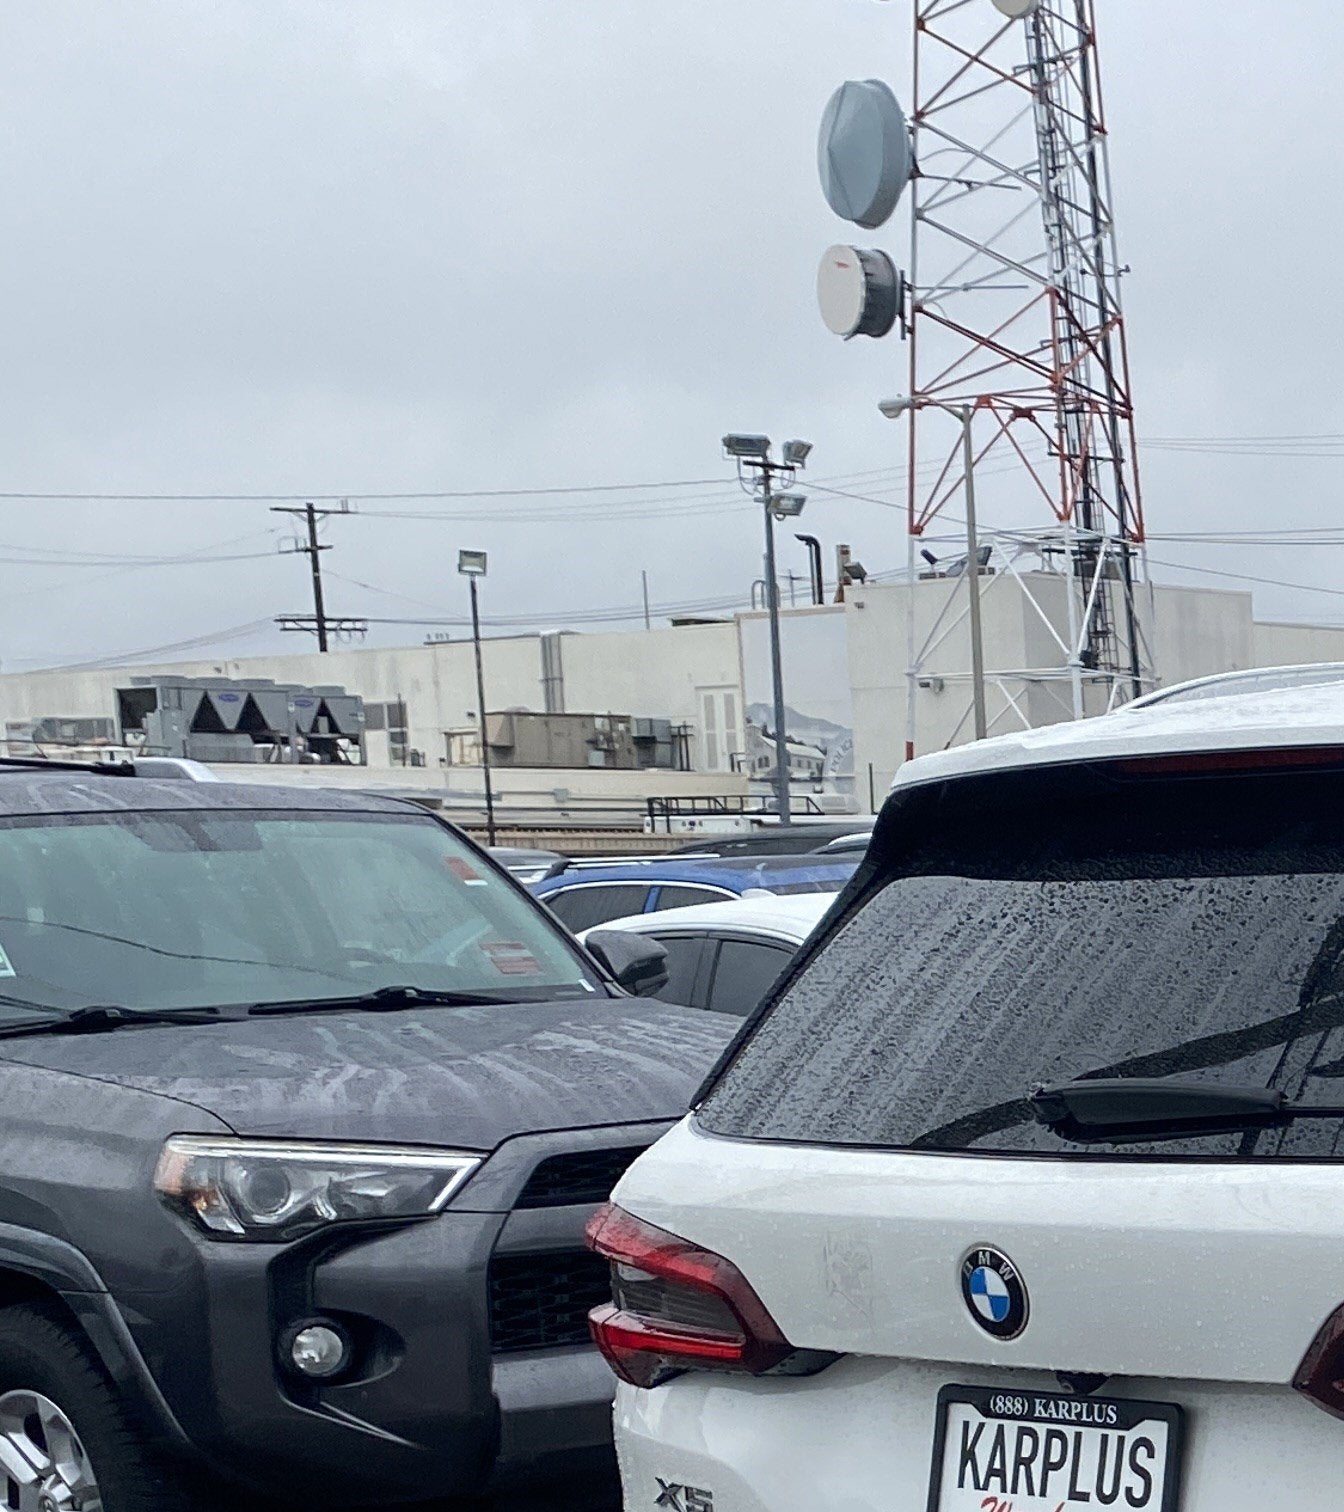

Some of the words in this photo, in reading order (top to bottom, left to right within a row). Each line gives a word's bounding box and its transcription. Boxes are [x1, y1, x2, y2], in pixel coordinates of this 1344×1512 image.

[963, 1251, 1015, 1281] BMW
[990, 1394, 1029, 1417] (888)
[1033, 1398, 1117, 1424] KARPLUS
[957, 1420, 1156, 1509] KARPLUS
